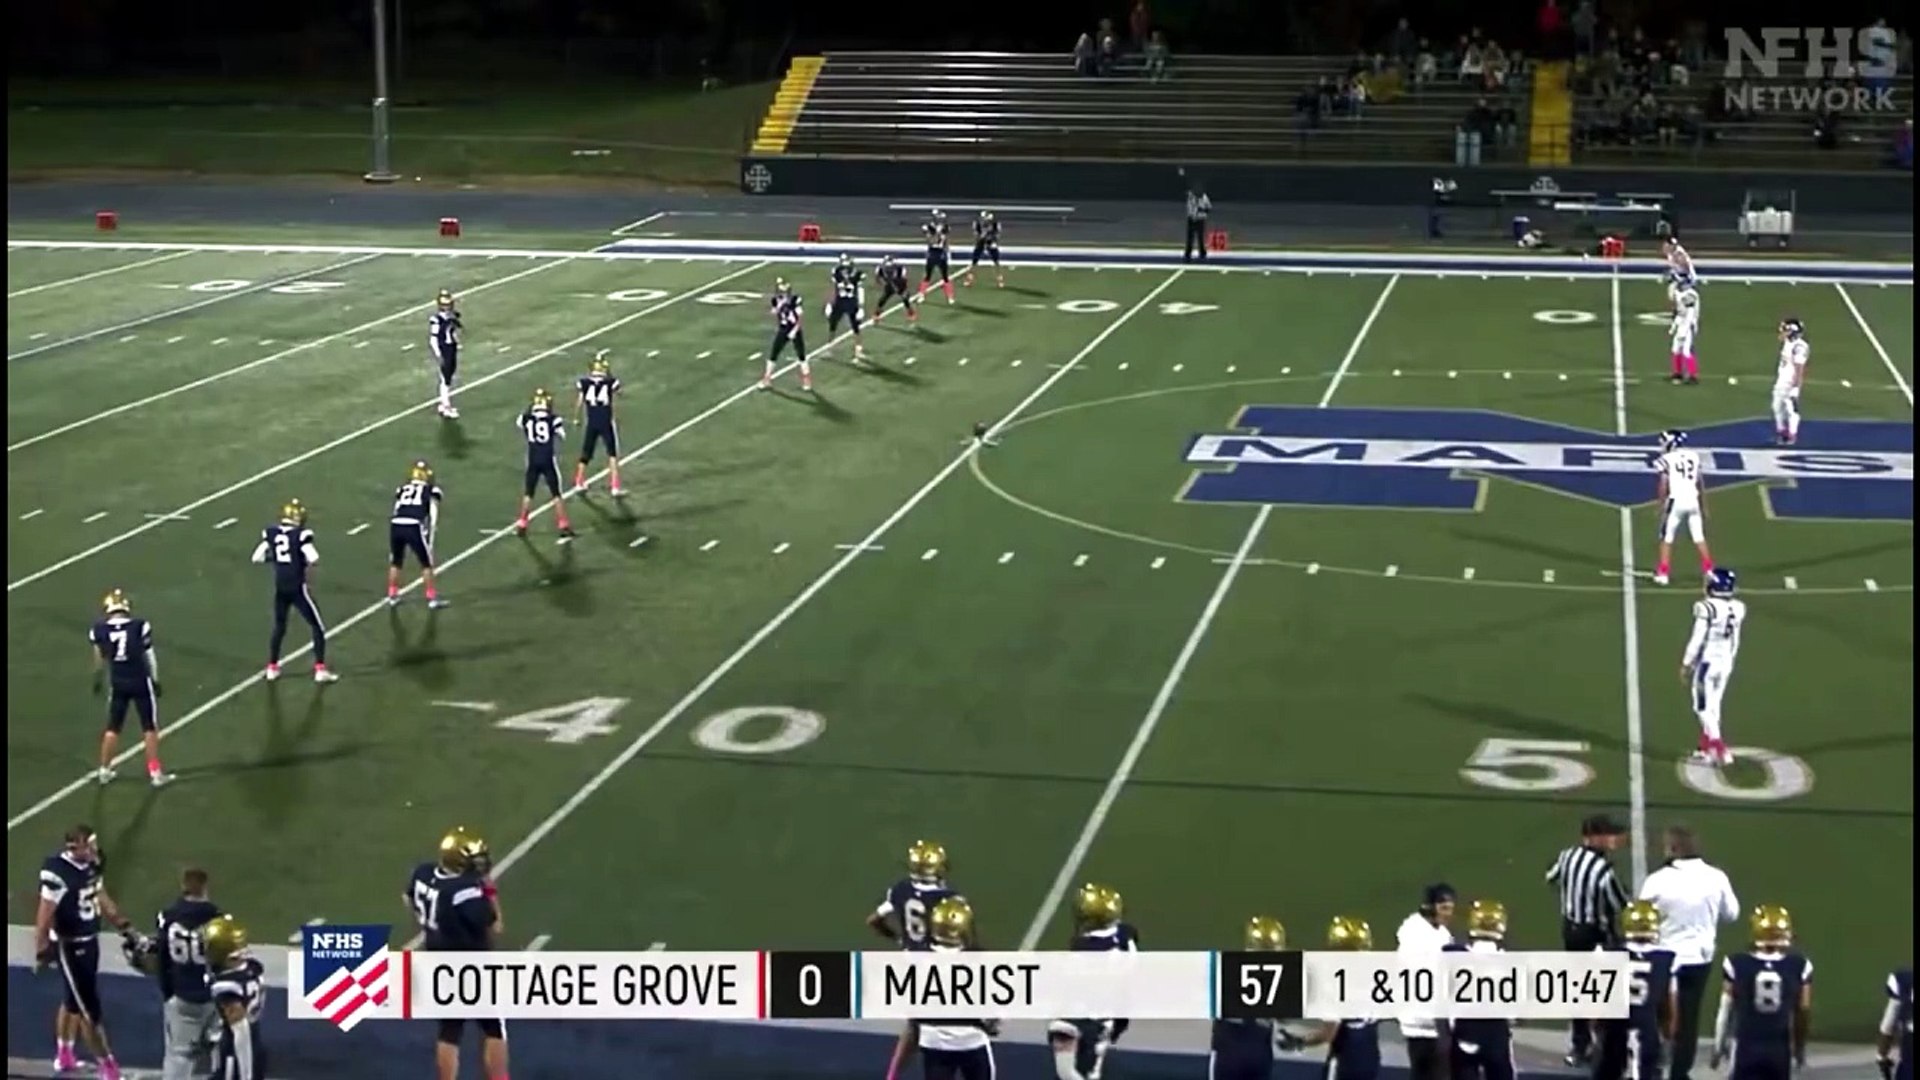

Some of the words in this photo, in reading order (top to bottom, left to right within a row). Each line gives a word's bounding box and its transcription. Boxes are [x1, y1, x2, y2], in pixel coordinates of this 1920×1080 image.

[585, 384, 609, 407] 44
[525, 419, 550, 444] 19
[400, 484, 423, 506] 21
[274, 533, 292, 563] 2
[108, 629, 128, 661] 7
[1754, 971, 1781, 1012] 8
